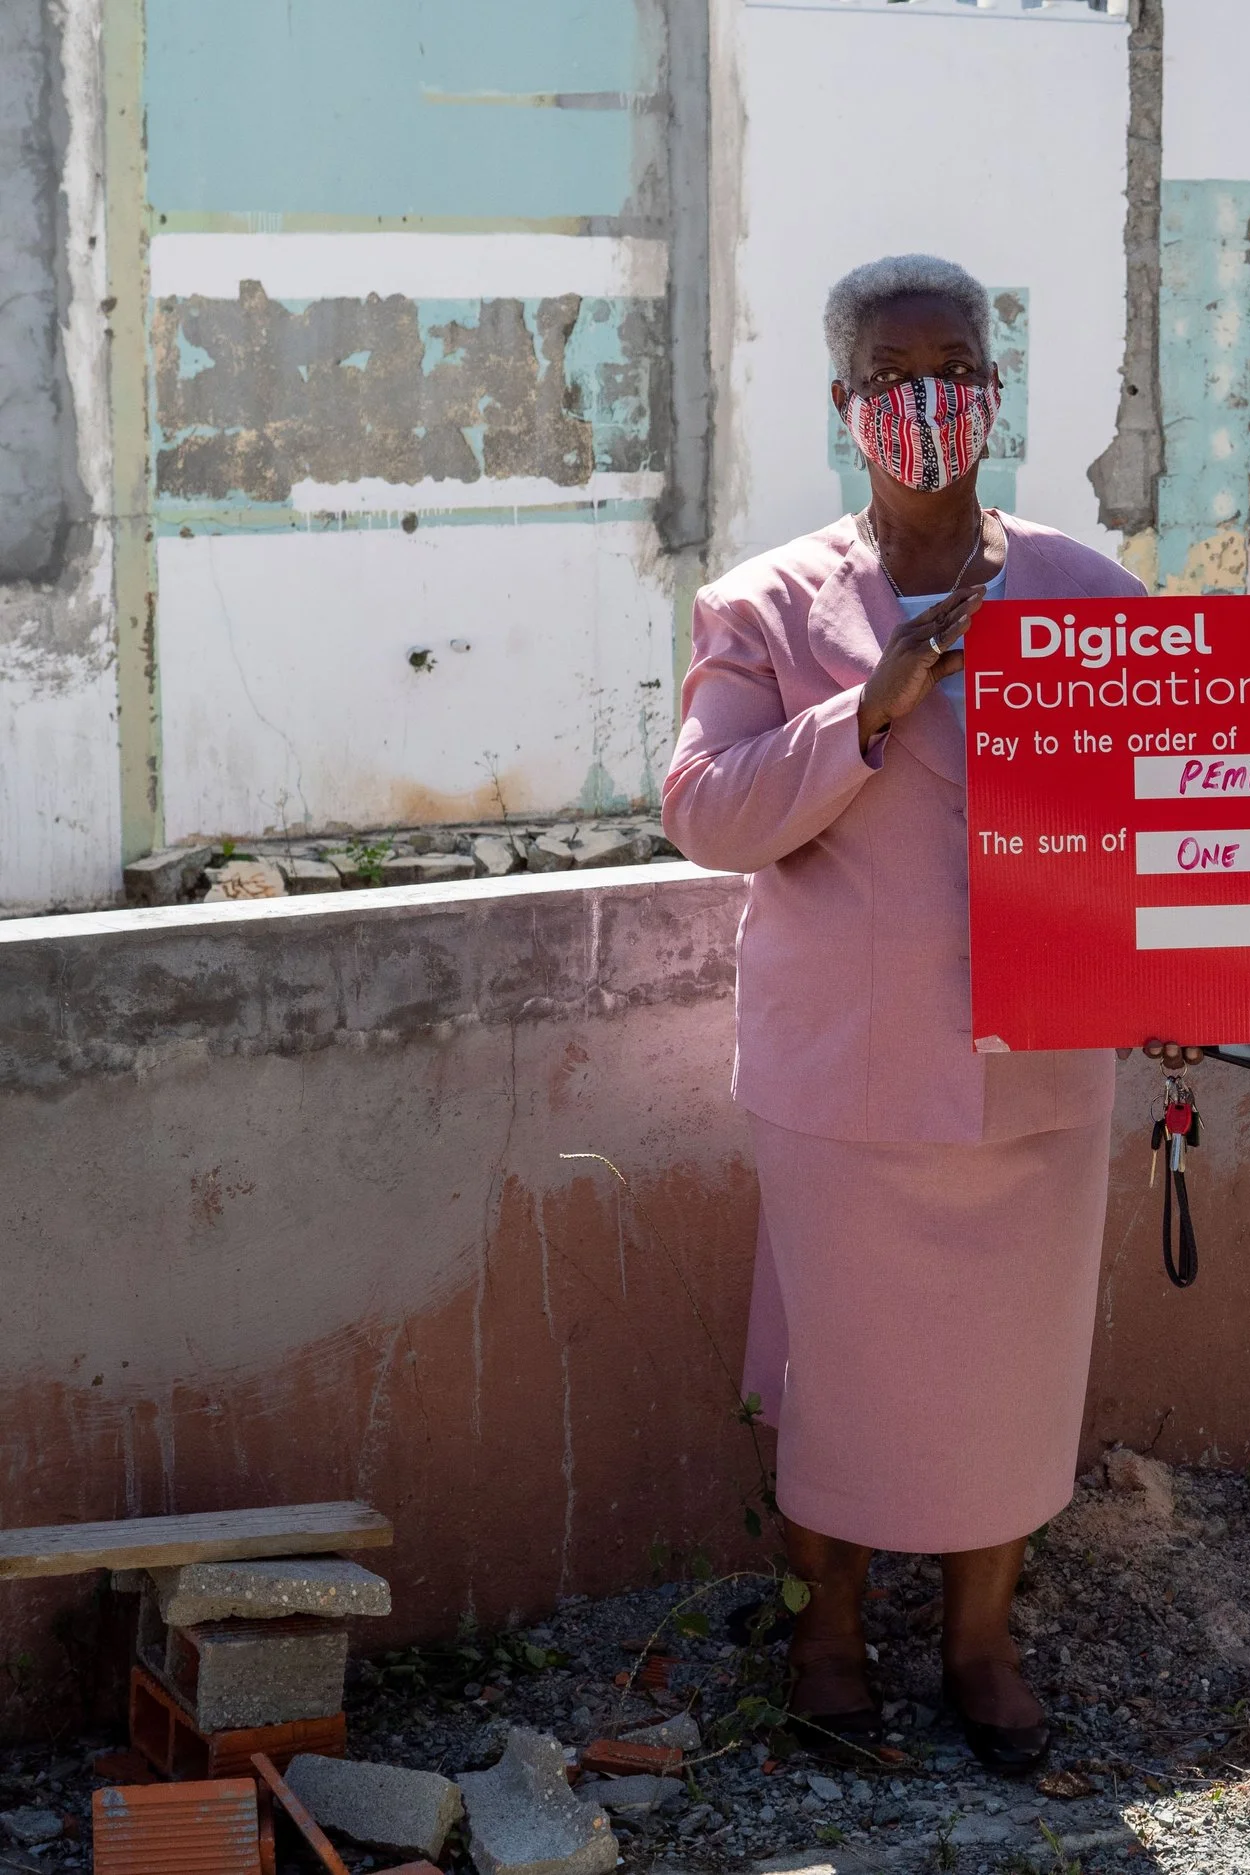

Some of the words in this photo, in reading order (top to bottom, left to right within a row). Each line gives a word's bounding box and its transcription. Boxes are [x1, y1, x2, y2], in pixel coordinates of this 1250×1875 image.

[1020, 613, 1212, 669] Digicel
[976, 732, 1019, 761] Pay
[1033, 731, 1059, 755] to
[1073, 729, 1113, 754] the
[1127, 727, 1197, 753] order
[1212, 726, 1237, 750] of
[978, 831, 1024, 855] The
[1038, 833, 1087, 854] sum
[1101, 827, 1127, 852] of
[1177, 836, 1240, 871] ONE
